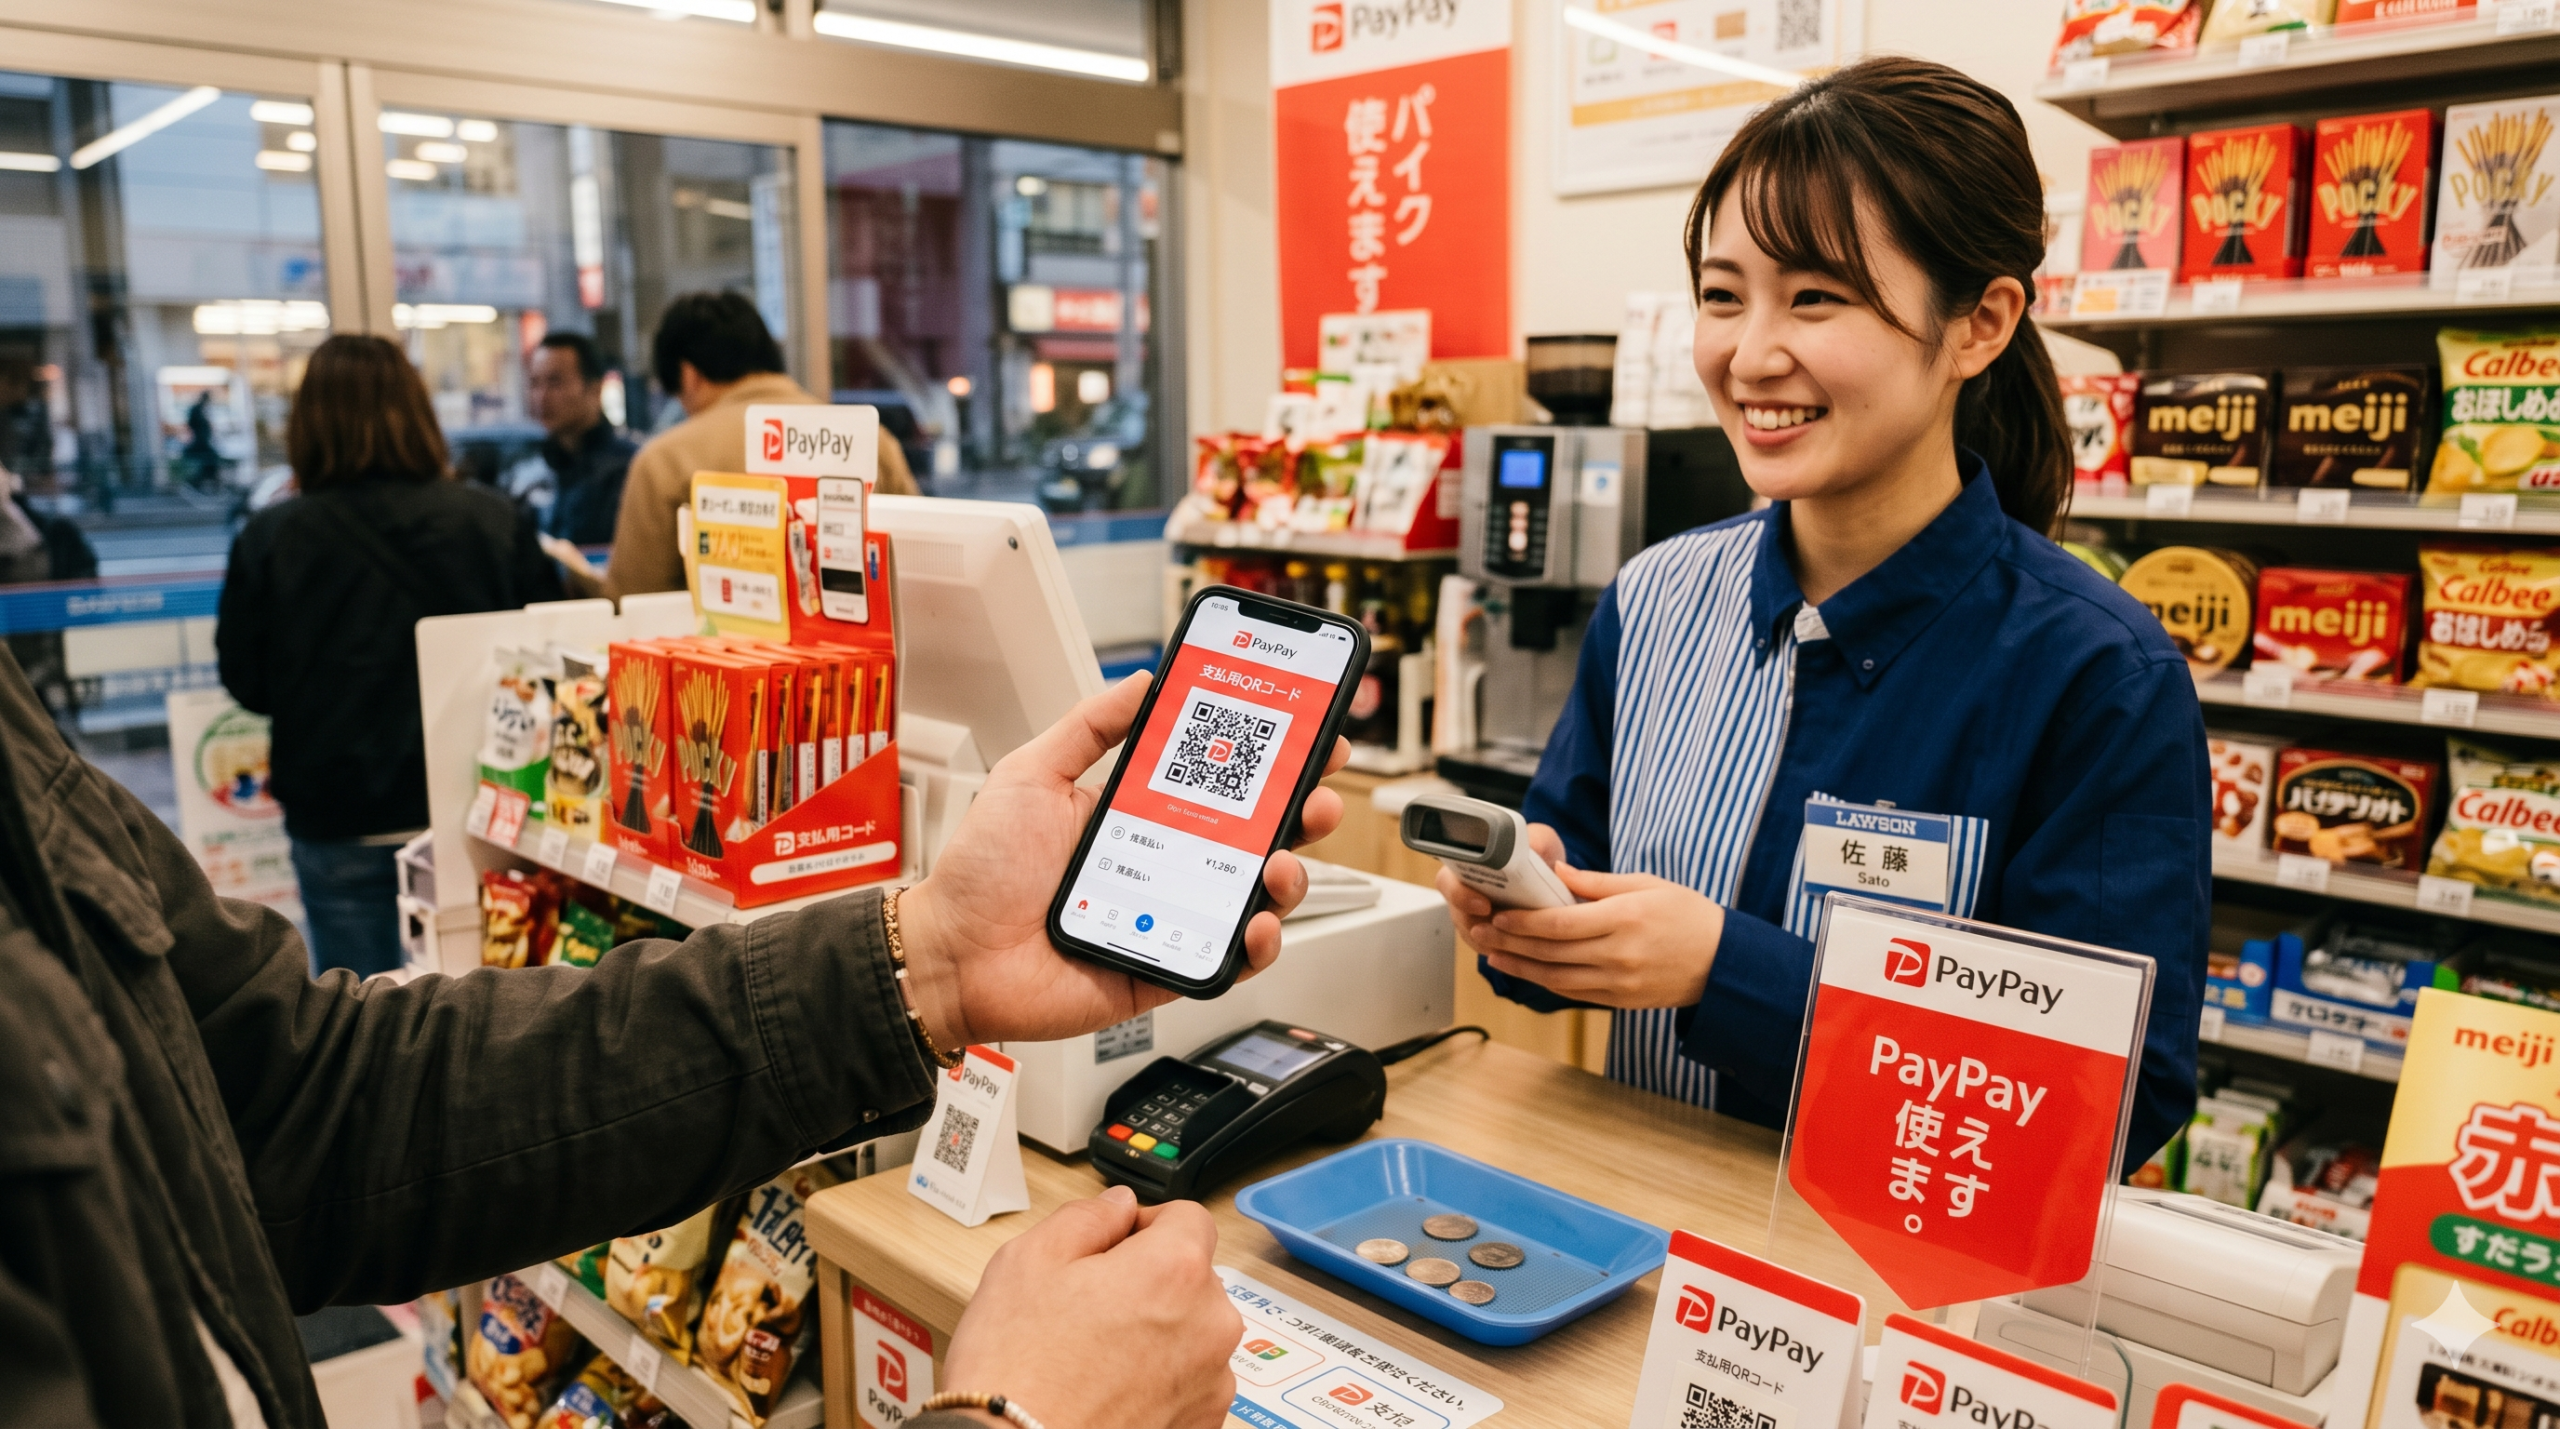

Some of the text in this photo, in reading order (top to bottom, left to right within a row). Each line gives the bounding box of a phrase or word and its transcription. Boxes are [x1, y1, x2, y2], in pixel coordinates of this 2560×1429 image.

[1352, 0, 1458, 39] PayPay
[1391, 83, 1437, 247] パイク
[1344, 97, 1389, 313] 使えます
[2463, 349, 2560, 378] Calbe
[2148, 394, 2257, 442] meiji
[2288, 392, 2409, 442] meiji
[787, 426, 853, 462] PayPay
[2440, 573, 2551, 611] Calbee
[2269, 599, 2389, 646] meiji
[1251, 637, 1298, 659] PayPay
[1199, 664, 1302, 701] 支払用QRコード
[1836, 811, 1917, 836] LAWSON
[1206, 858, 1237, 874] ¥1,280
[1858, 872, 1890, 888] Sato
[1935, 955, 2064, 1015] PayPay
[2454, 1027, 2555, 1068] meiji
[962, 1067, 1001, 1099] PayPay
[1869, 1035, 2048, 1127] PayPay
[1717, 1305, 1825, 1373] PayPay
[1694, 1348, 1785, 1395] 支払用QRコード
[1949, 1384, 2049, 1429] PayP
